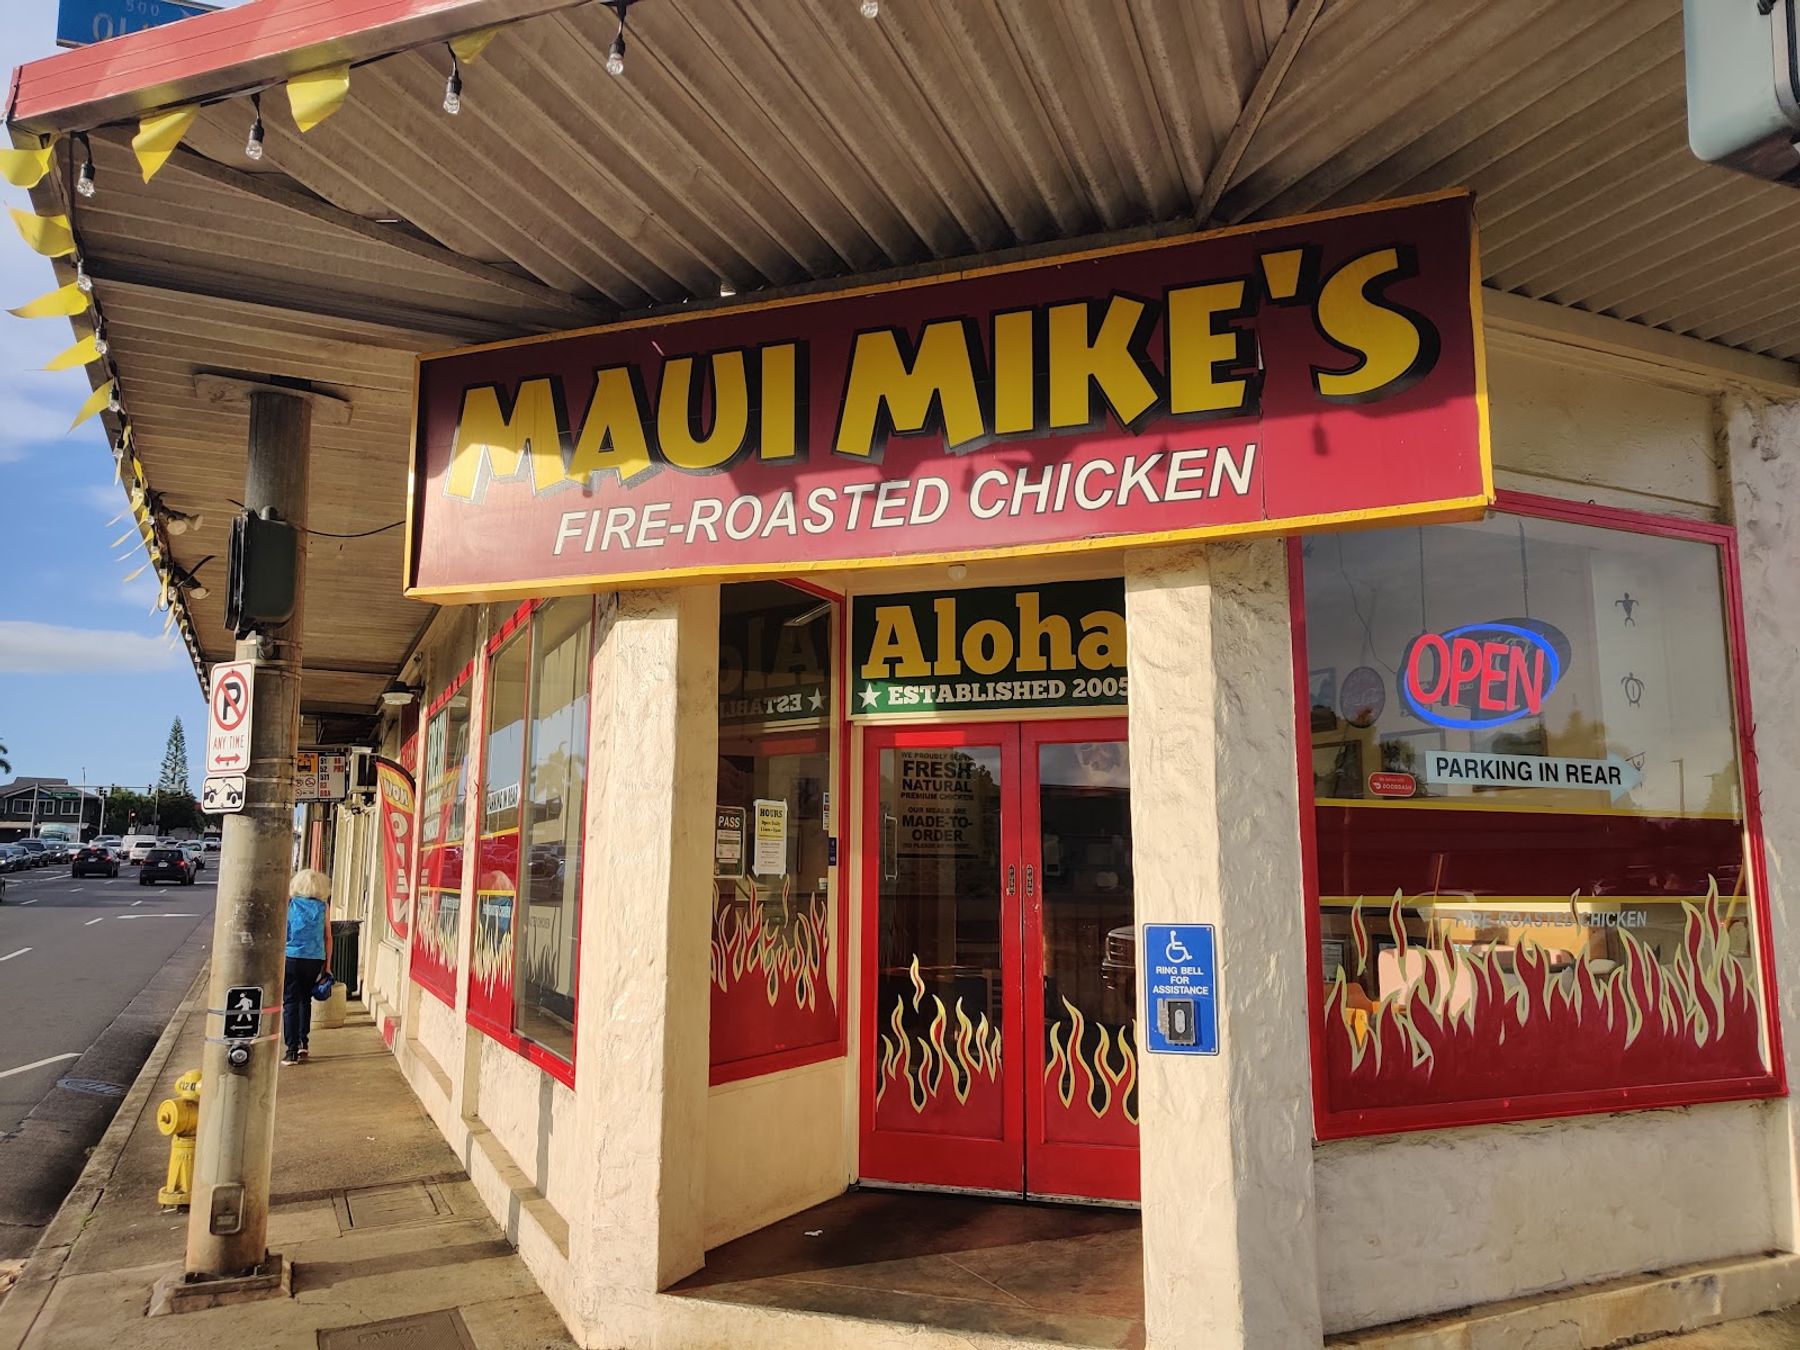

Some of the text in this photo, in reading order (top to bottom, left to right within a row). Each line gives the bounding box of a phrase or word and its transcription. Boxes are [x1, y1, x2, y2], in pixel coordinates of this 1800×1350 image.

[442, 246, 1428, 502] MAUI MIKE'S
[553, 442, 1258, 557] FIRE-ROASTED CHICKEN
[861, 592, 1127, 679] Aloha
[1407, 633, 1545, 716] OPEN
[888, 677, 1129, 705] ESTABLISHED 2005
[213, 734, 245, 750] ANY TIME
[903, 760, 972, 779] FRESH
[1435, 757, 1622, 785] PARKING IN REAR
[902, 778, 972, 793] NATURAL
[900, 792, 937, 800] PREMIUM
[760, 808, 783, 818] HOURS
[718, 815, 741, 828] PASS
[902, 814, 973, 828] MADE-TO-
[911, 829, 963, 842] ORDER
[1580, 910, 1648, 927] CHICKEN
[1155, 966, 1204, 975] RING BELL
[1170, 976, 1189, 984] FOR
[1152, 985, 1209, 995] ASSISTANCE
